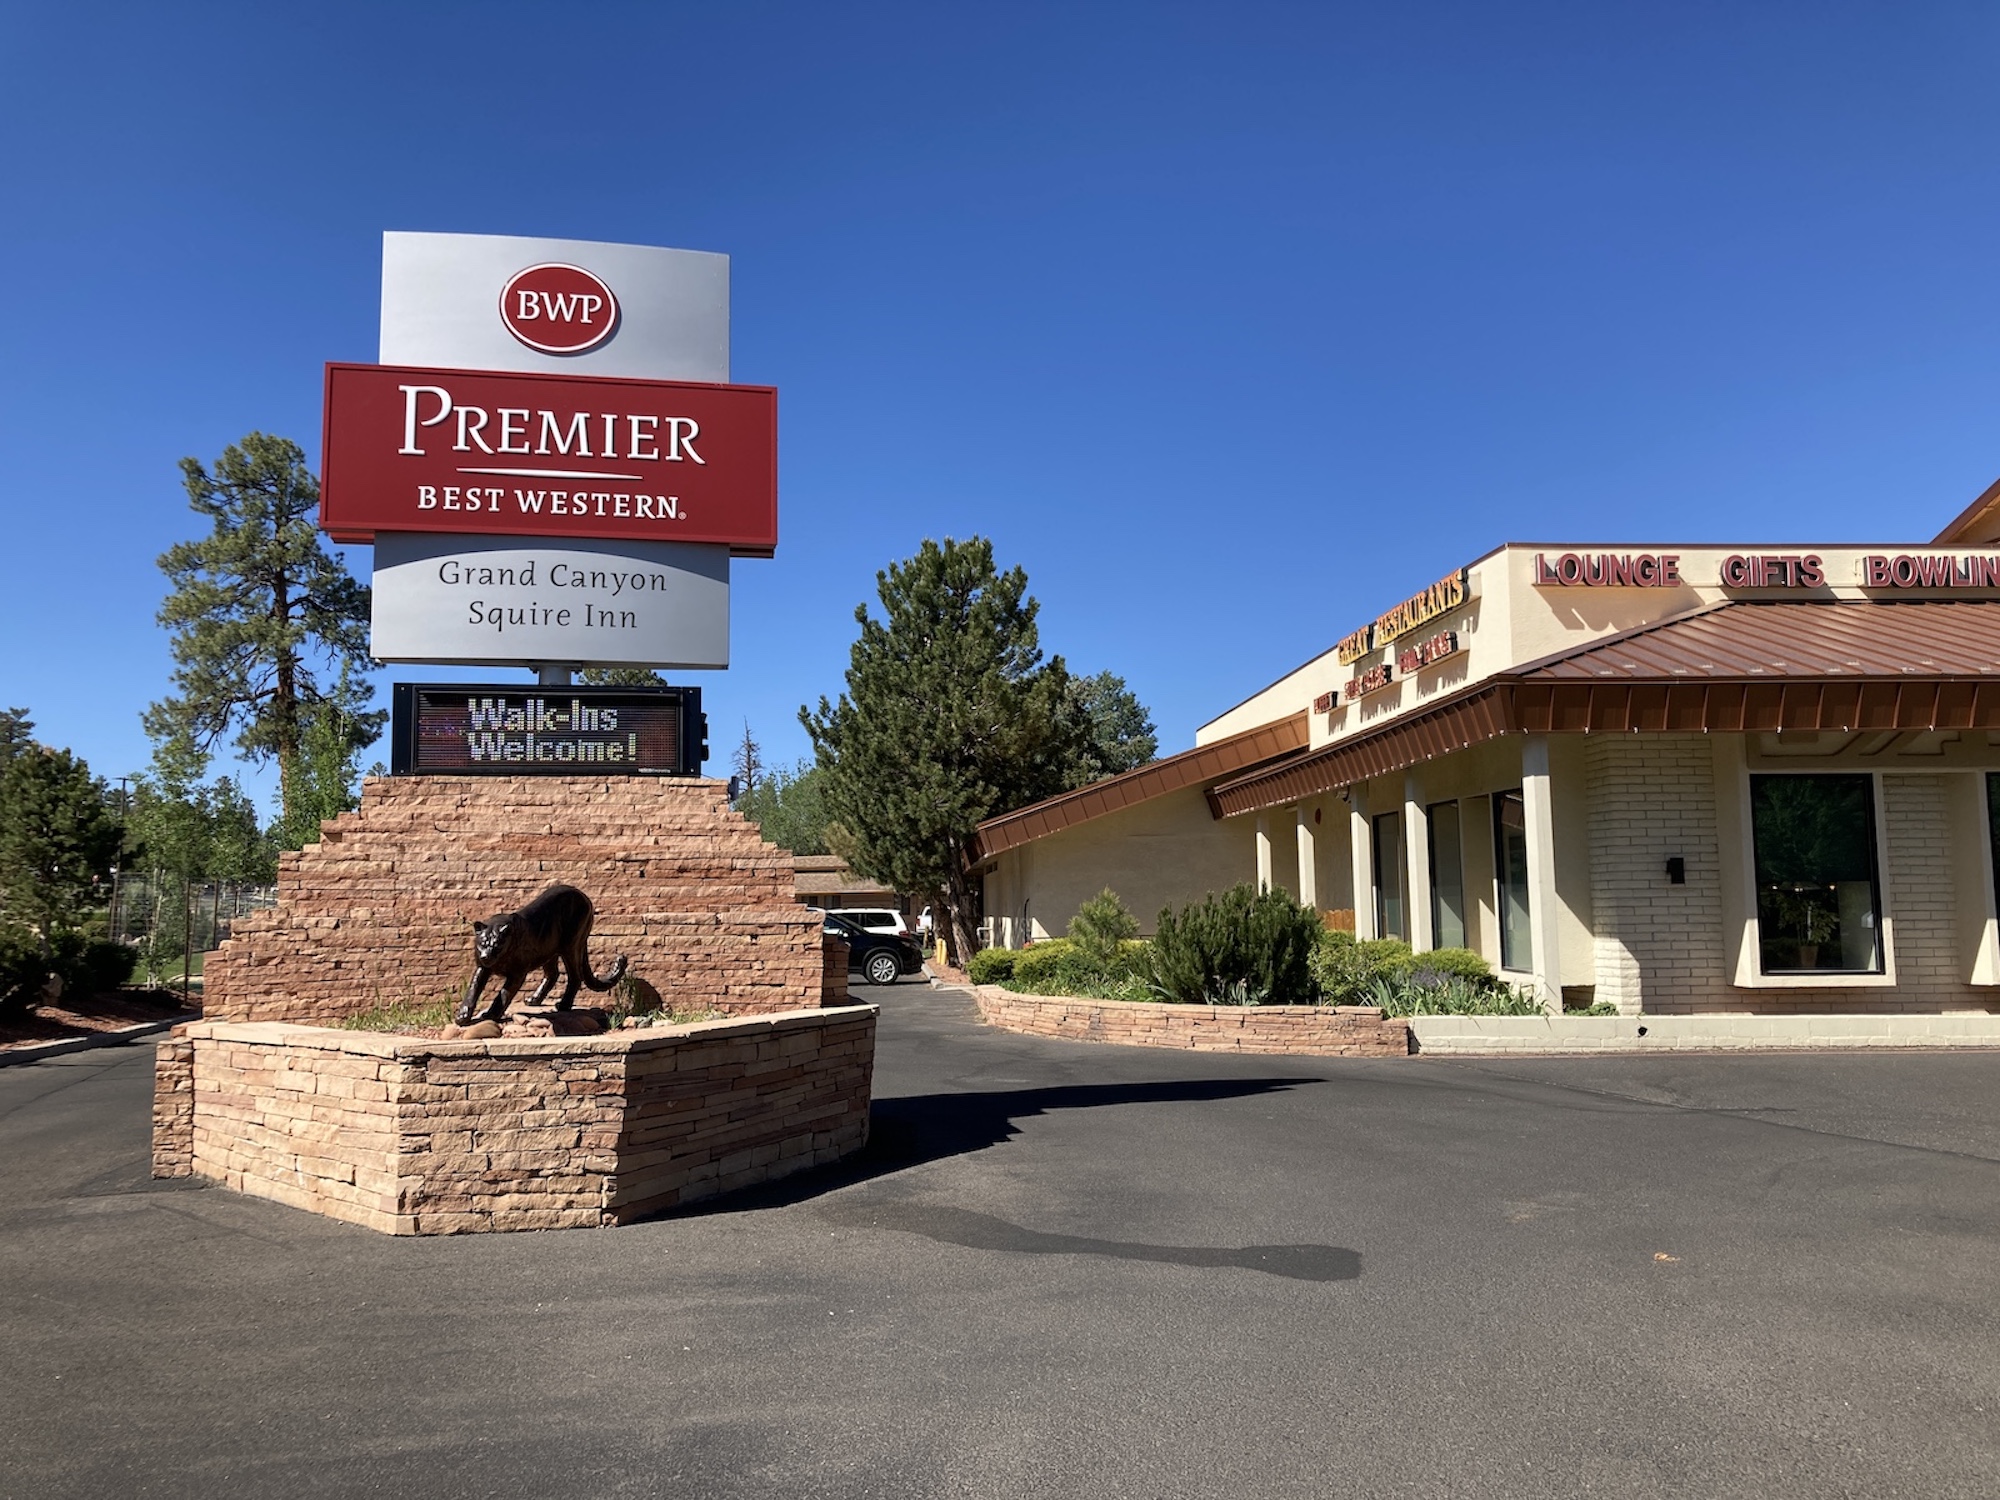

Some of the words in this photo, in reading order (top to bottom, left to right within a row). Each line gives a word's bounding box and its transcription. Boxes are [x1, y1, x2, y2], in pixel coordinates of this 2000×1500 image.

[516, 289, 603, 325] BWP
[397, 384, 706, 465] PREMIER
[417, 485, 505, 513] BEST
[438, 559, 538, 588] Grand
[549, 563, 668, 597] Canyon
[1534, 553, 1681, 587] LOUNGE
[1720, 553, 1825, 588] GIFTS
[468, 600, 572, 632] Squire
[584, 603, 638, 628] Inn
[1337, 625, 1370, 667] GREAT
[1375, 568, 1466, 647] RESTAURANTS
[467, 697, 619, 732] Walk-Ins
[467, 732, 637, 762] Welcome!
